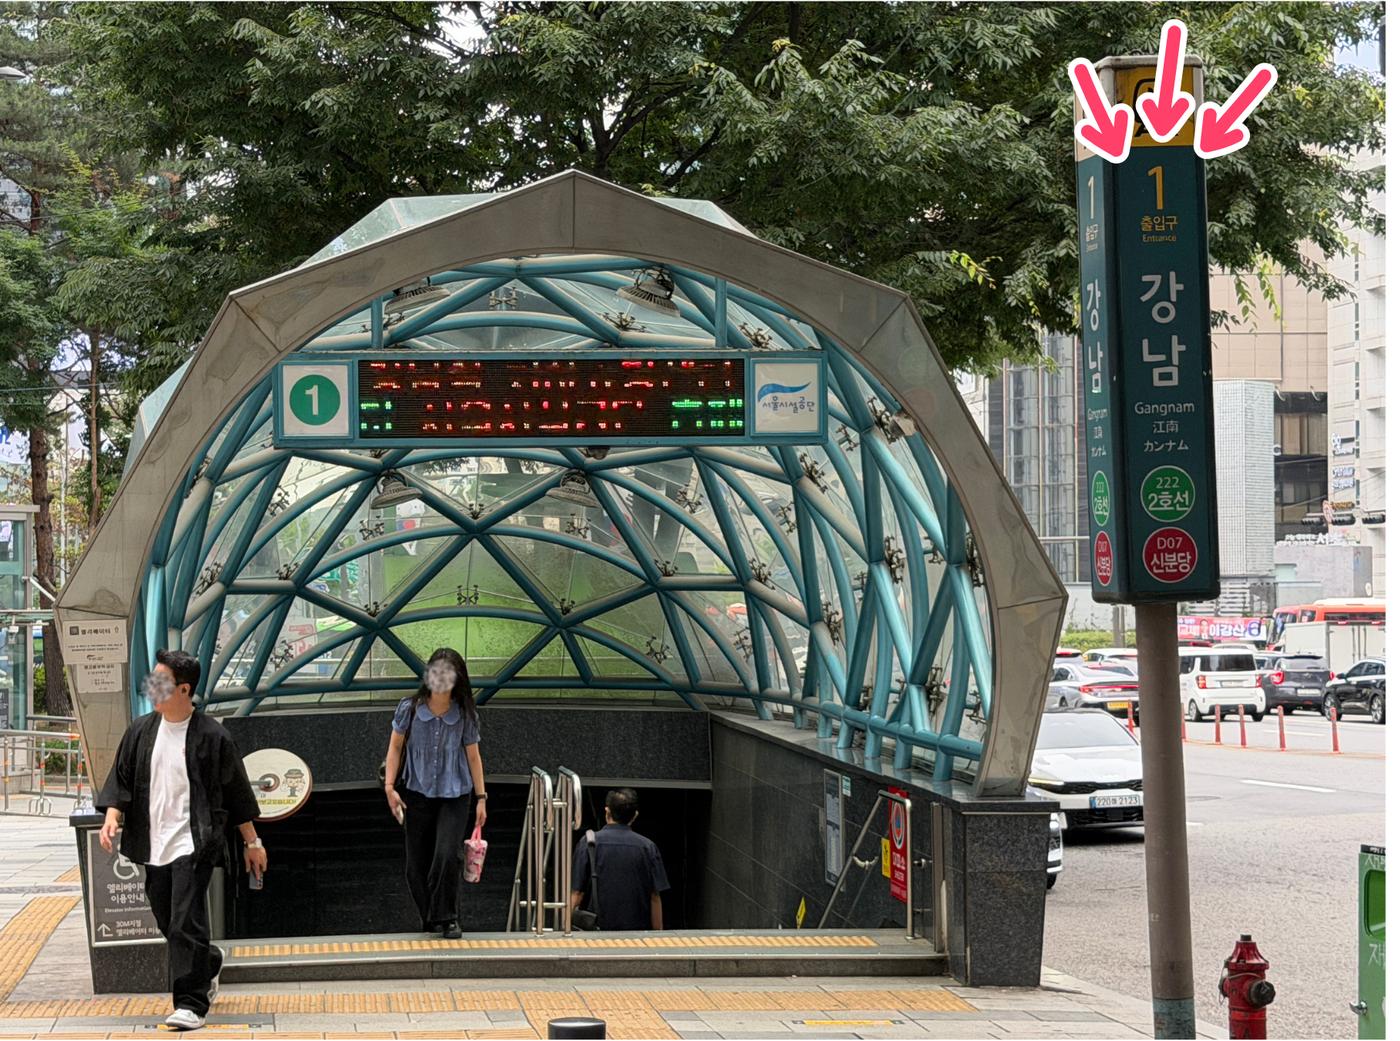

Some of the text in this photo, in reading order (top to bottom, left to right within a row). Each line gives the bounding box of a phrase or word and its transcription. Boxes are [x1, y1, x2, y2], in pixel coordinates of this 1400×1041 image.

[1147, 165, 1164, 210] 1
[1087, 175, 1095, 220] 1
[1141, 215, 1178, 232] 출입구
[1142, 234, 1177, 243] Entrance
[1086, 278, 1103, 393] 강남
[1140, 271, 1186, 388] 강남
[304, 384, 319, 416] 1
[762, 395, 815, 414] 서울시설공단
[1134, 401, 1195, 416] Gangnam
[1152, 420, 1179, 434] 江南
[1143, 440, 1189, 453] カンナム
[1156, 477, 1180, 489] 222
[1148, 491, 1189, 511] 2호선
[1157, 537, 1183, 550] D07
[1150, 552, 1192, 574] 신분당
[1120, 795, 1138, 805] 2123
